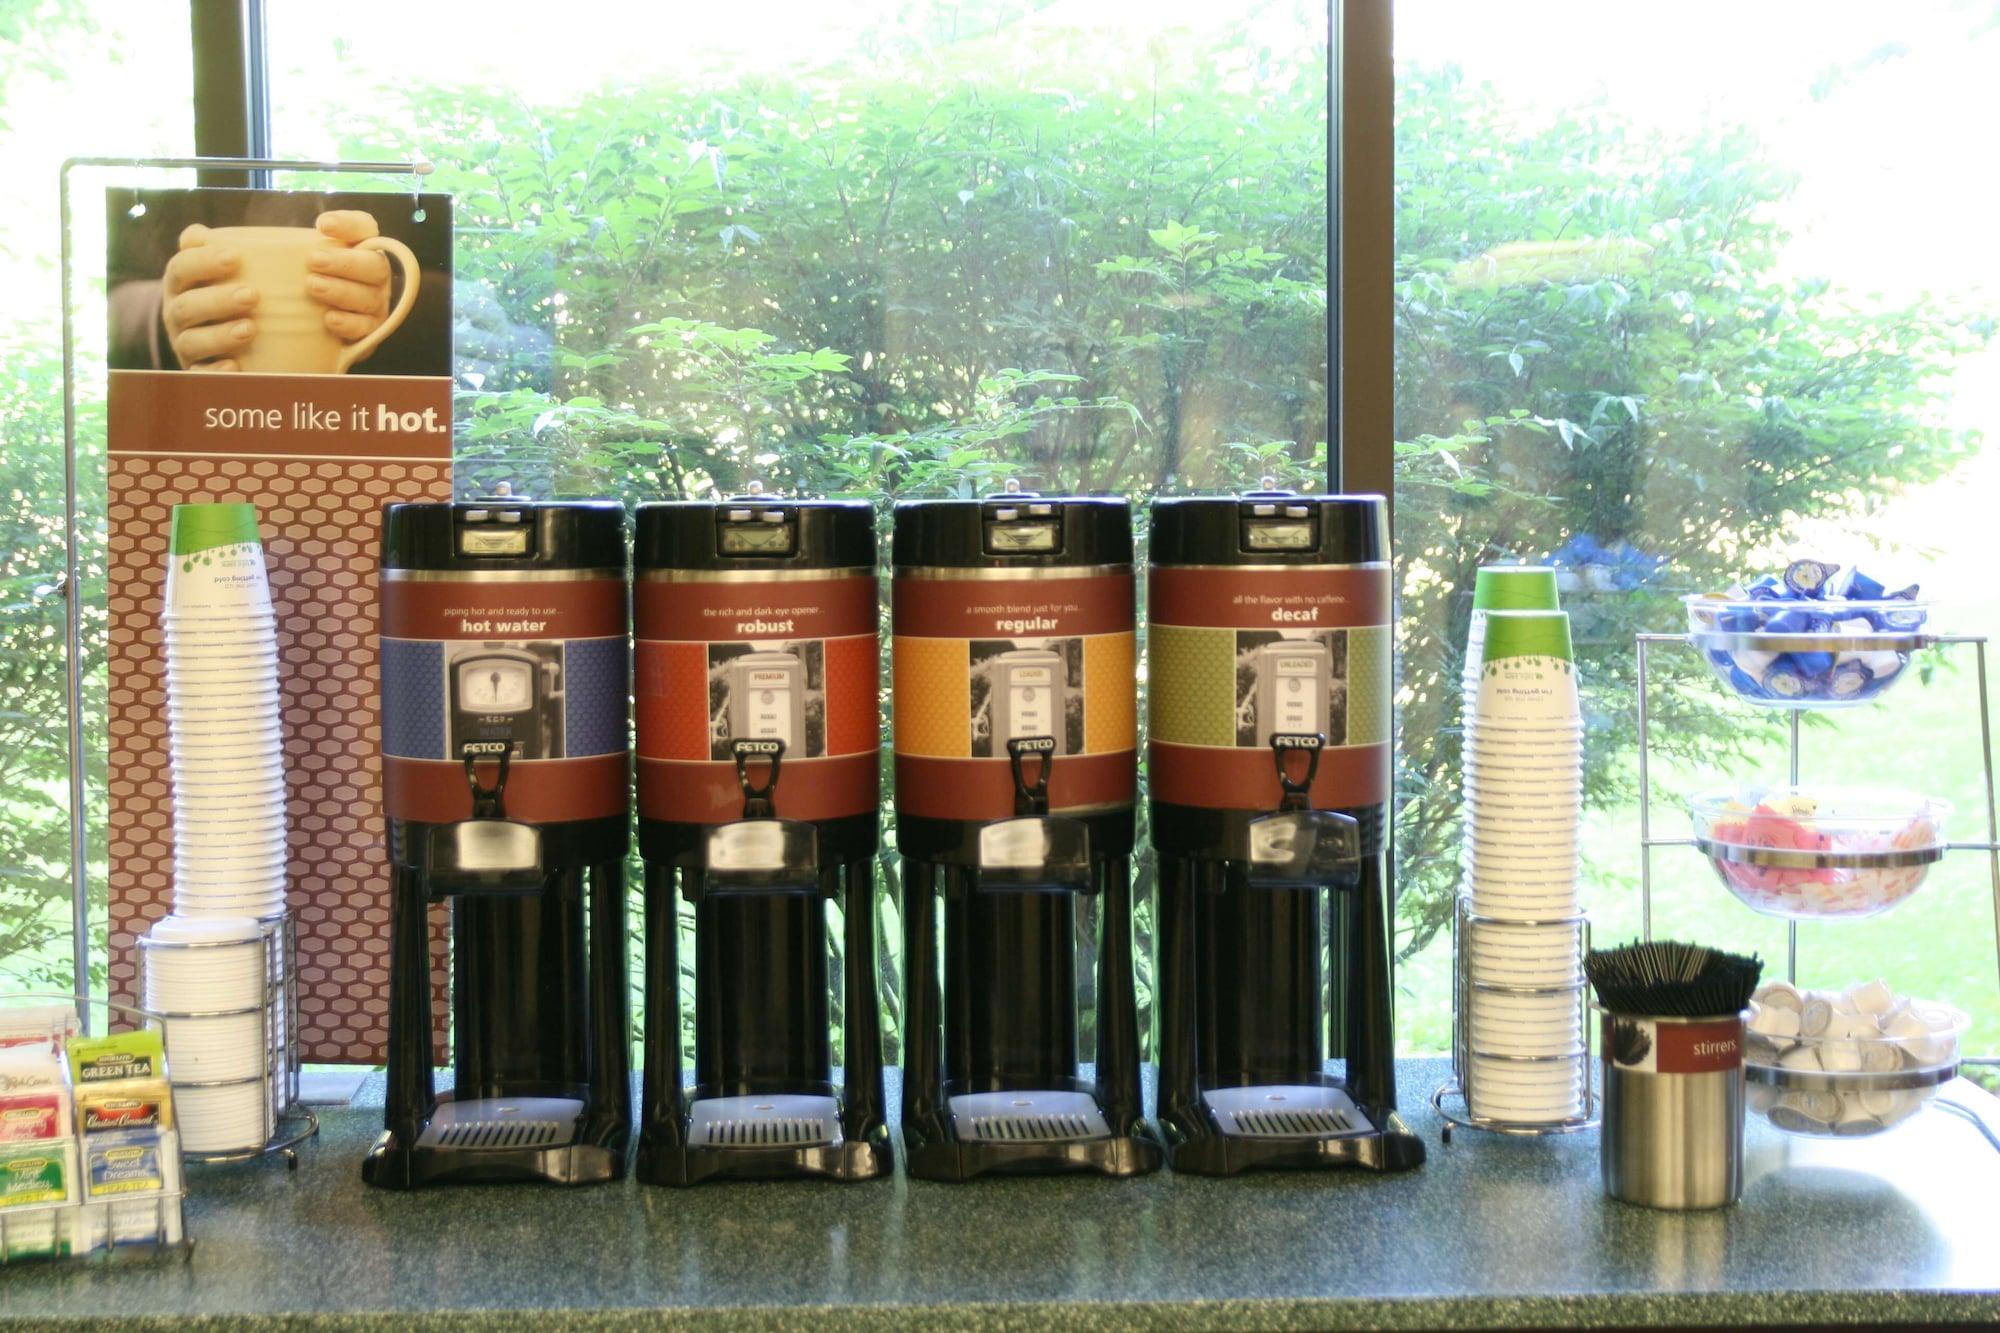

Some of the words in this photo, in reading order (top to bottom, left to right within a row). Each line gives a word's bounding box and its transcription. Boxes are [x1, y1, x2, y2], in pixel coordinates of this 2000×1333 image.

[205, 406, 283, 430] some
[293, 401, 342, 431] like
[352, 403, 370, 431] it
[377, 403, 447, 433] hot.
[1232, 595, 1243, 604] all
[1244, 595, 1258, 604] the
[1284, 595, 1303, 604] with
[444, 607, 469, 617] piping
[471, 606, 485, 616] hot
[488, 606, 504, 615] and
[506, 606, 530, 617] ready
[532, 607, 540, 615] to
[703, 608, 718, 616] the
[718, 607, 735, 616] rich
[736, 607, 753, 616] and
[754, 606, 772, 616] dark
[775, 608, 790, 617] eye
[974, 605, 1005, 614] smooth
[1006, 604, 1031, 614] blend
[1032, 604, 1049, 614] just
[1050, 603, 1062, 612] for
[1271, 606, 1318, 621] decaf
[462, 618, 492, 632] hot
[496, 619, 547, 632] water
[736, 618, 794, 633] robust
[996, 616, 1058, 634] regular
[754, 672, 785, 681] PREMIUM
[736, 741, 780, 752] FETCO
[1017, 738, 1054, 751] FETCO
[1276, 735, 1320, 747] FETCO
[463, 742, 506, 753] FETCO
[1693, 1039, 1737, 1056] stirrers
[82, 1064, 124, 1079] GREEN
[125, 1062, 152, 1075] TEA
